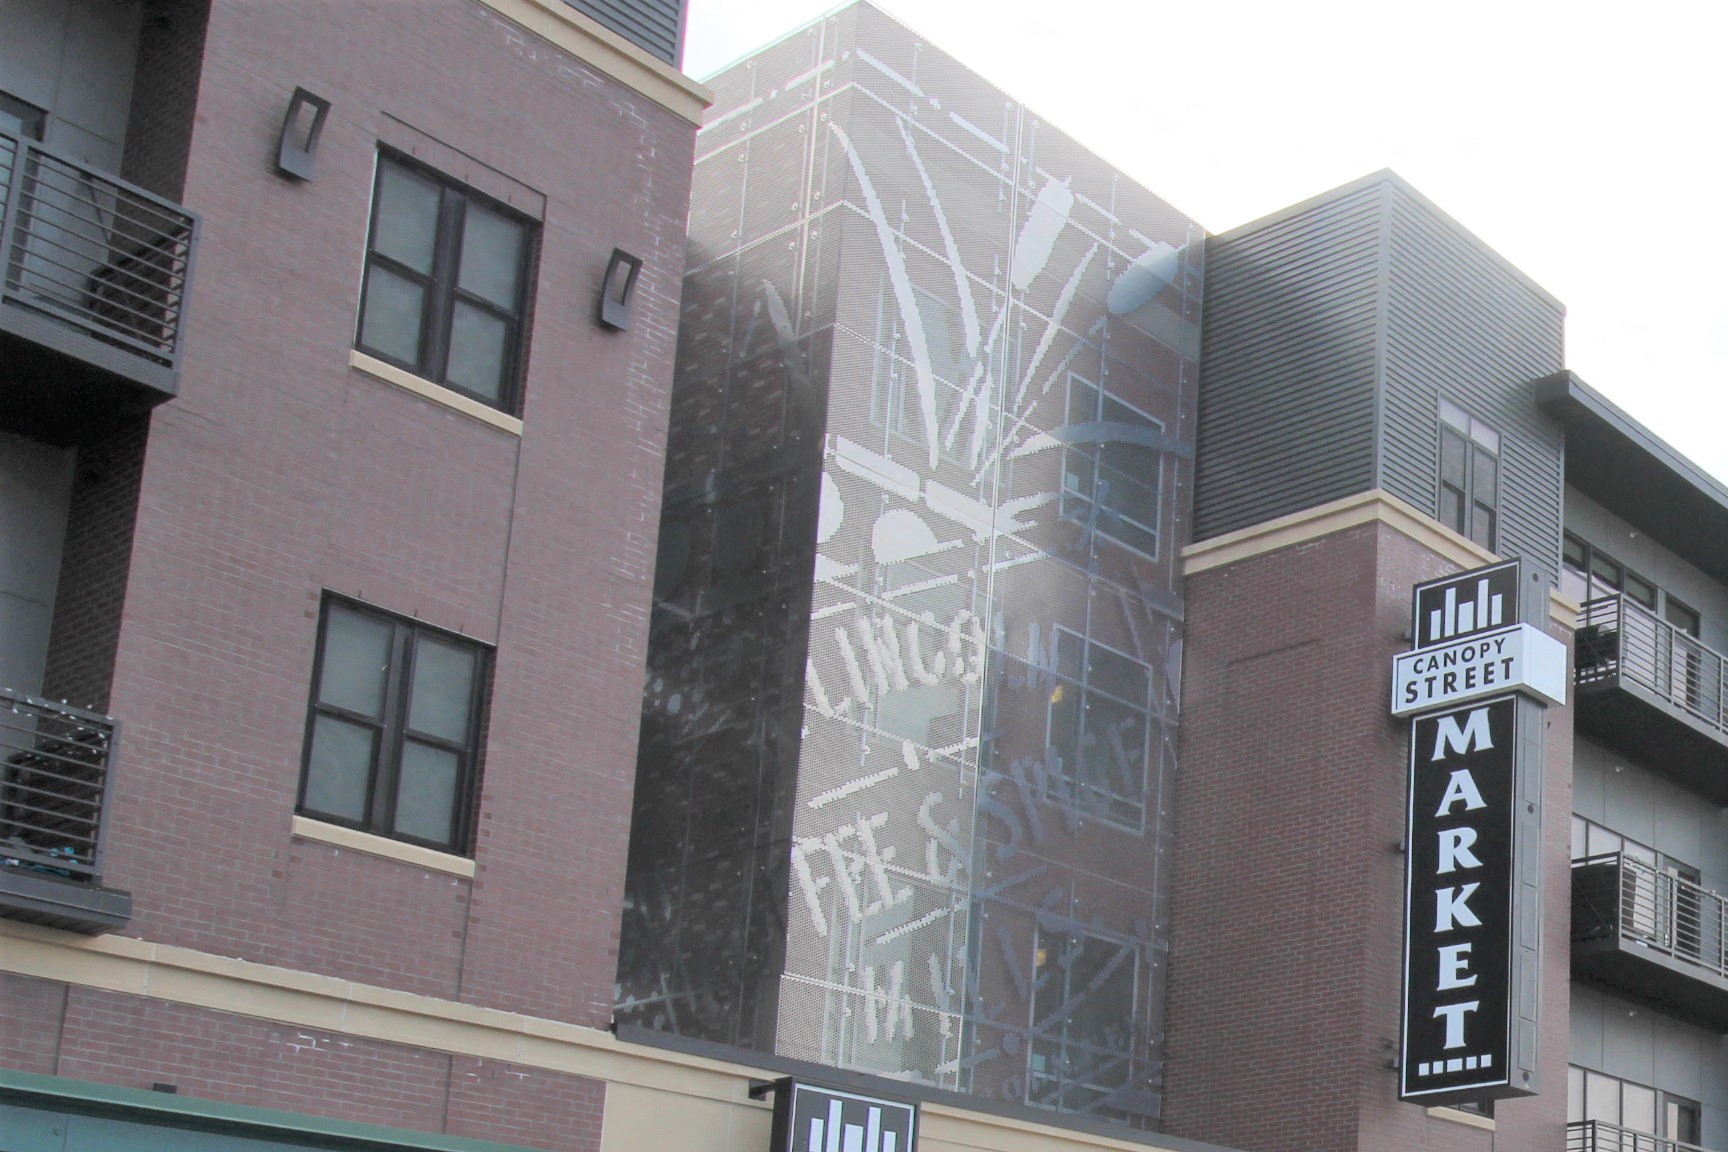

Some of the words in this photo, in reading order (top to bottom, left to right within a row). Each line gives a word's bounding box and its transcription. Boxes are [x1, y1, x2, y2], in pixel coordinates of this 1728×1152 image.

[1405, 656, 1514, 704] STREET
[1413, 637, 1506, 675] CANOPY
[1430, 707, 1495, 1050] MARKET
